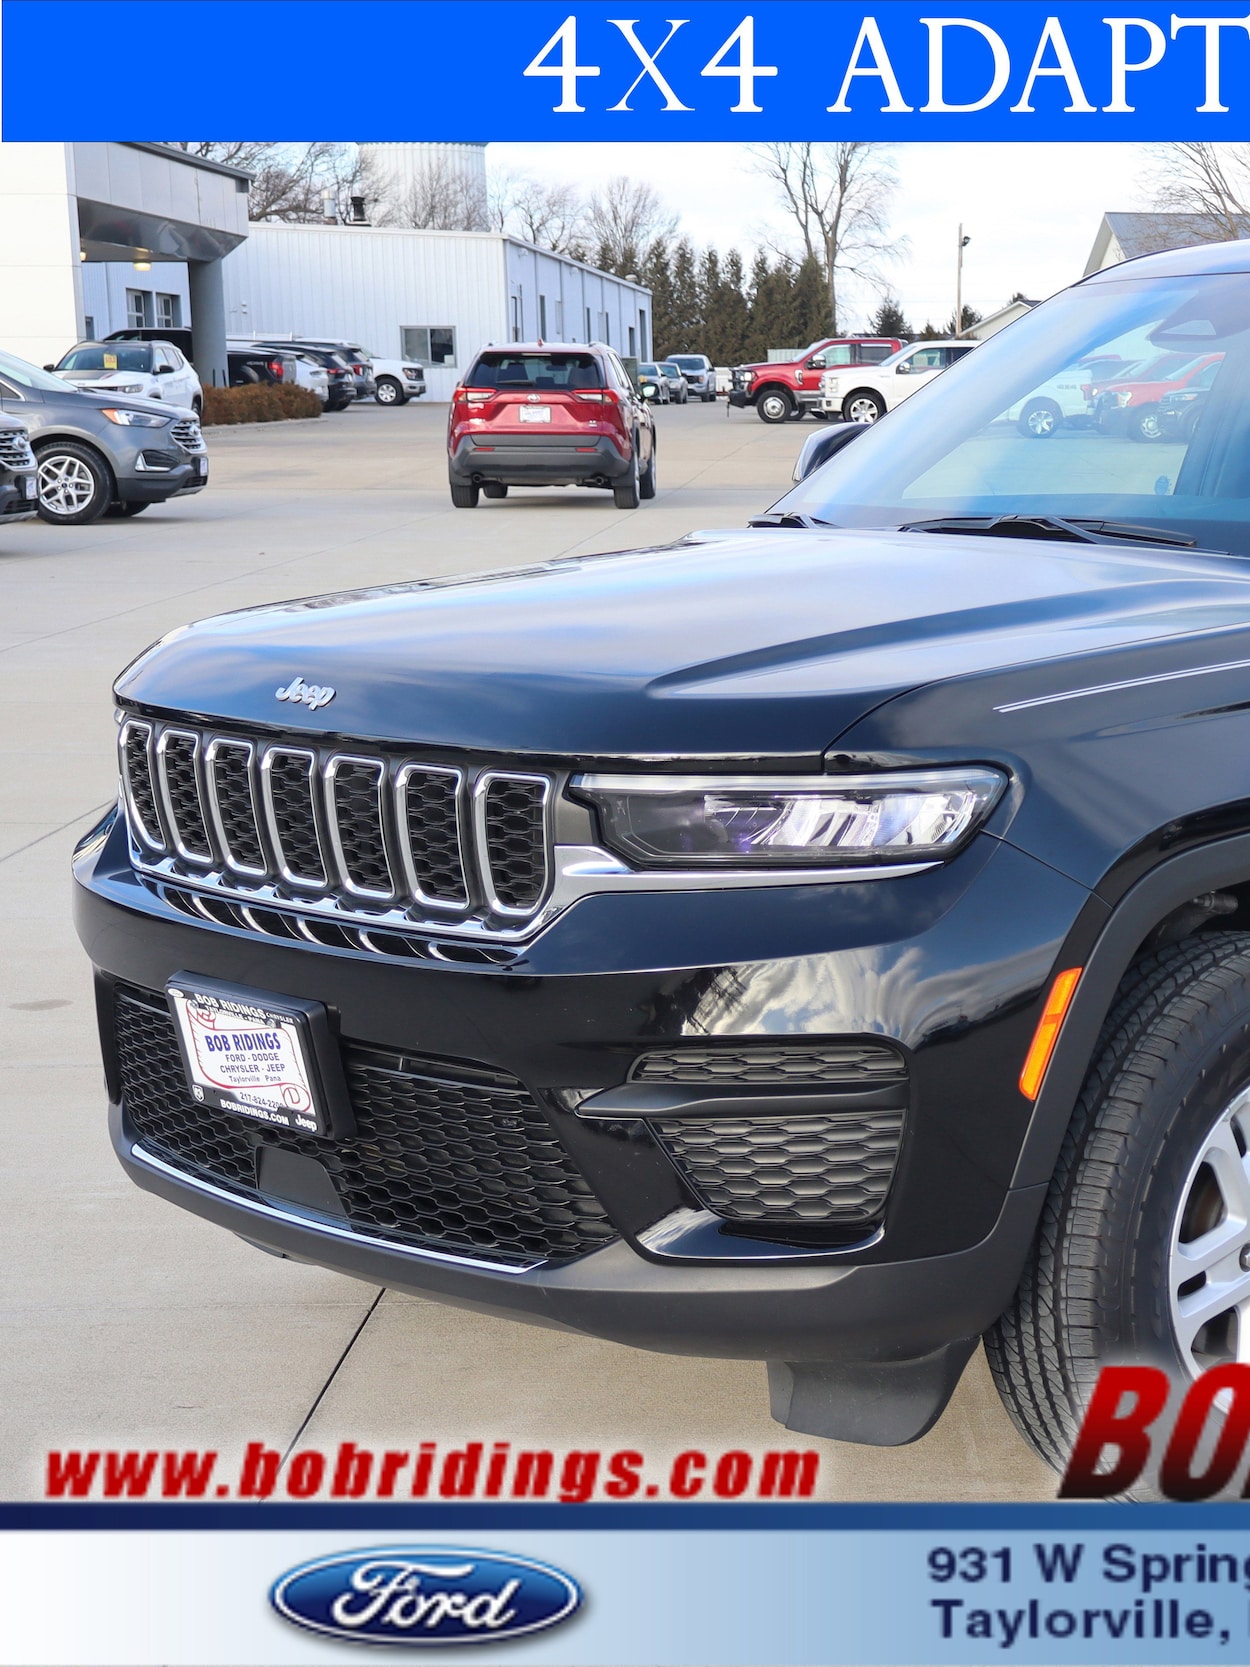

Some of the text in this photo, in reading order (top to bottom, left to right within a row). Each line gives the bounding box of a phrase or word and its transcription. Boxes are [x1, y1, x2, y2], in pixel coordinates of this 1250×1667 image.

[275, 677, 336, 711] Jeep
[194, 993, 220, 1008] BOB
[221, 1000, 267, 1020] RIDINGS
[204, 1032, 281, 1052] BOB RIDINGS
[225, 1053, 246, 1062] FORD
[251, 1053, 280, 1062] DODGE
[220, 1065, 260, 1073] CHRYSLER
[266, 1063, 285, 1072] JEEP
[229, 1075, 260, 1084] Taylorville
[220, 1099, 317, 1132] BOBRIDINGS.COM Jeep
